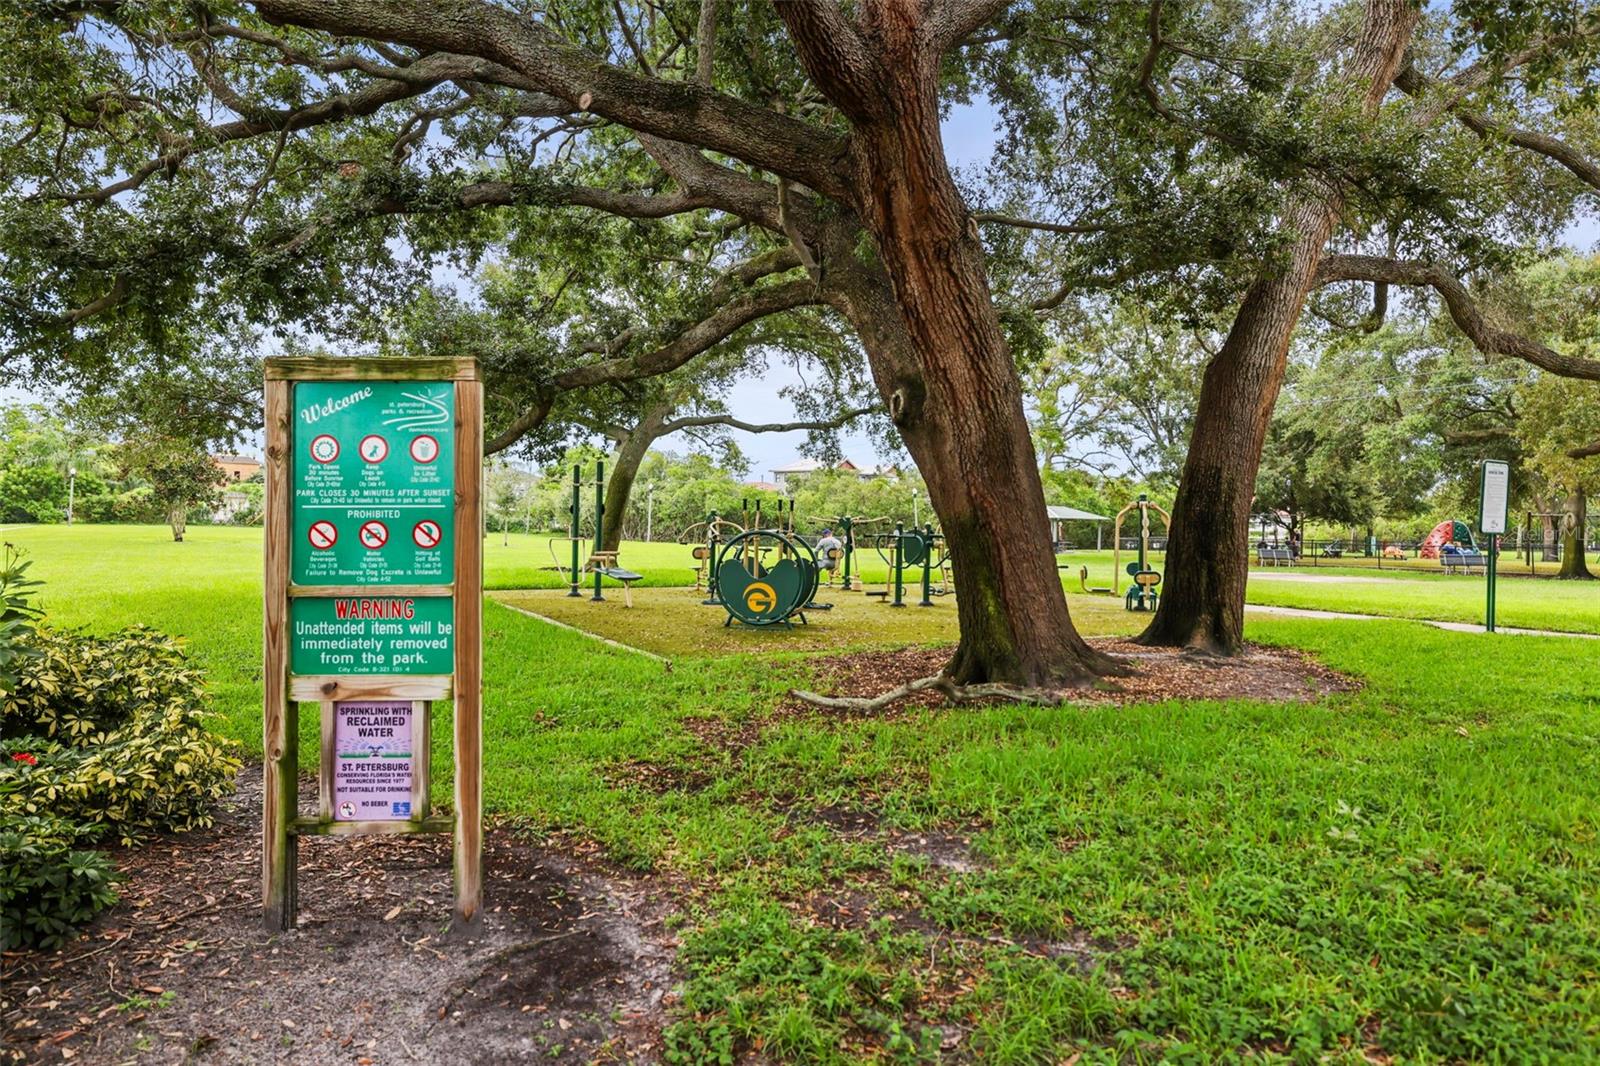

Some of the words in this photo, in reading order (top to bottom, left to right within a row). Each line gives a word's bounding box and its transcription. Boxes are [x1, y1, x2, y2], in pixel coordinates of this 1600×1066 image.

[301, 386, 372, 424] Welcome
[347, 510, 400, 518] PROHIBITED
[335, 599, 414, 620] WARNING
[296, 621, 364, 634] Unattended
[371, 621, 403, 634] items
[409, 621, 431, 634] will
[438, 621, 452, 634] be
[301, 637, 383, 652] immediately
[390, 638, 448, 649] removed
[320, 652, 354, 664] from
[362, 652, 385, 664] the
[393, 652, 428, 666] park.
[340, 707, 389, 715] SPRINKLING
[391, 707, 412, 715] WITH
[347, 717, 405, 726] RECLAIMED
[358, 728, 393, 737] WATER
[342, 763, 353, 771] ST.
[356, 763, 409, 771] PETERSBURG
